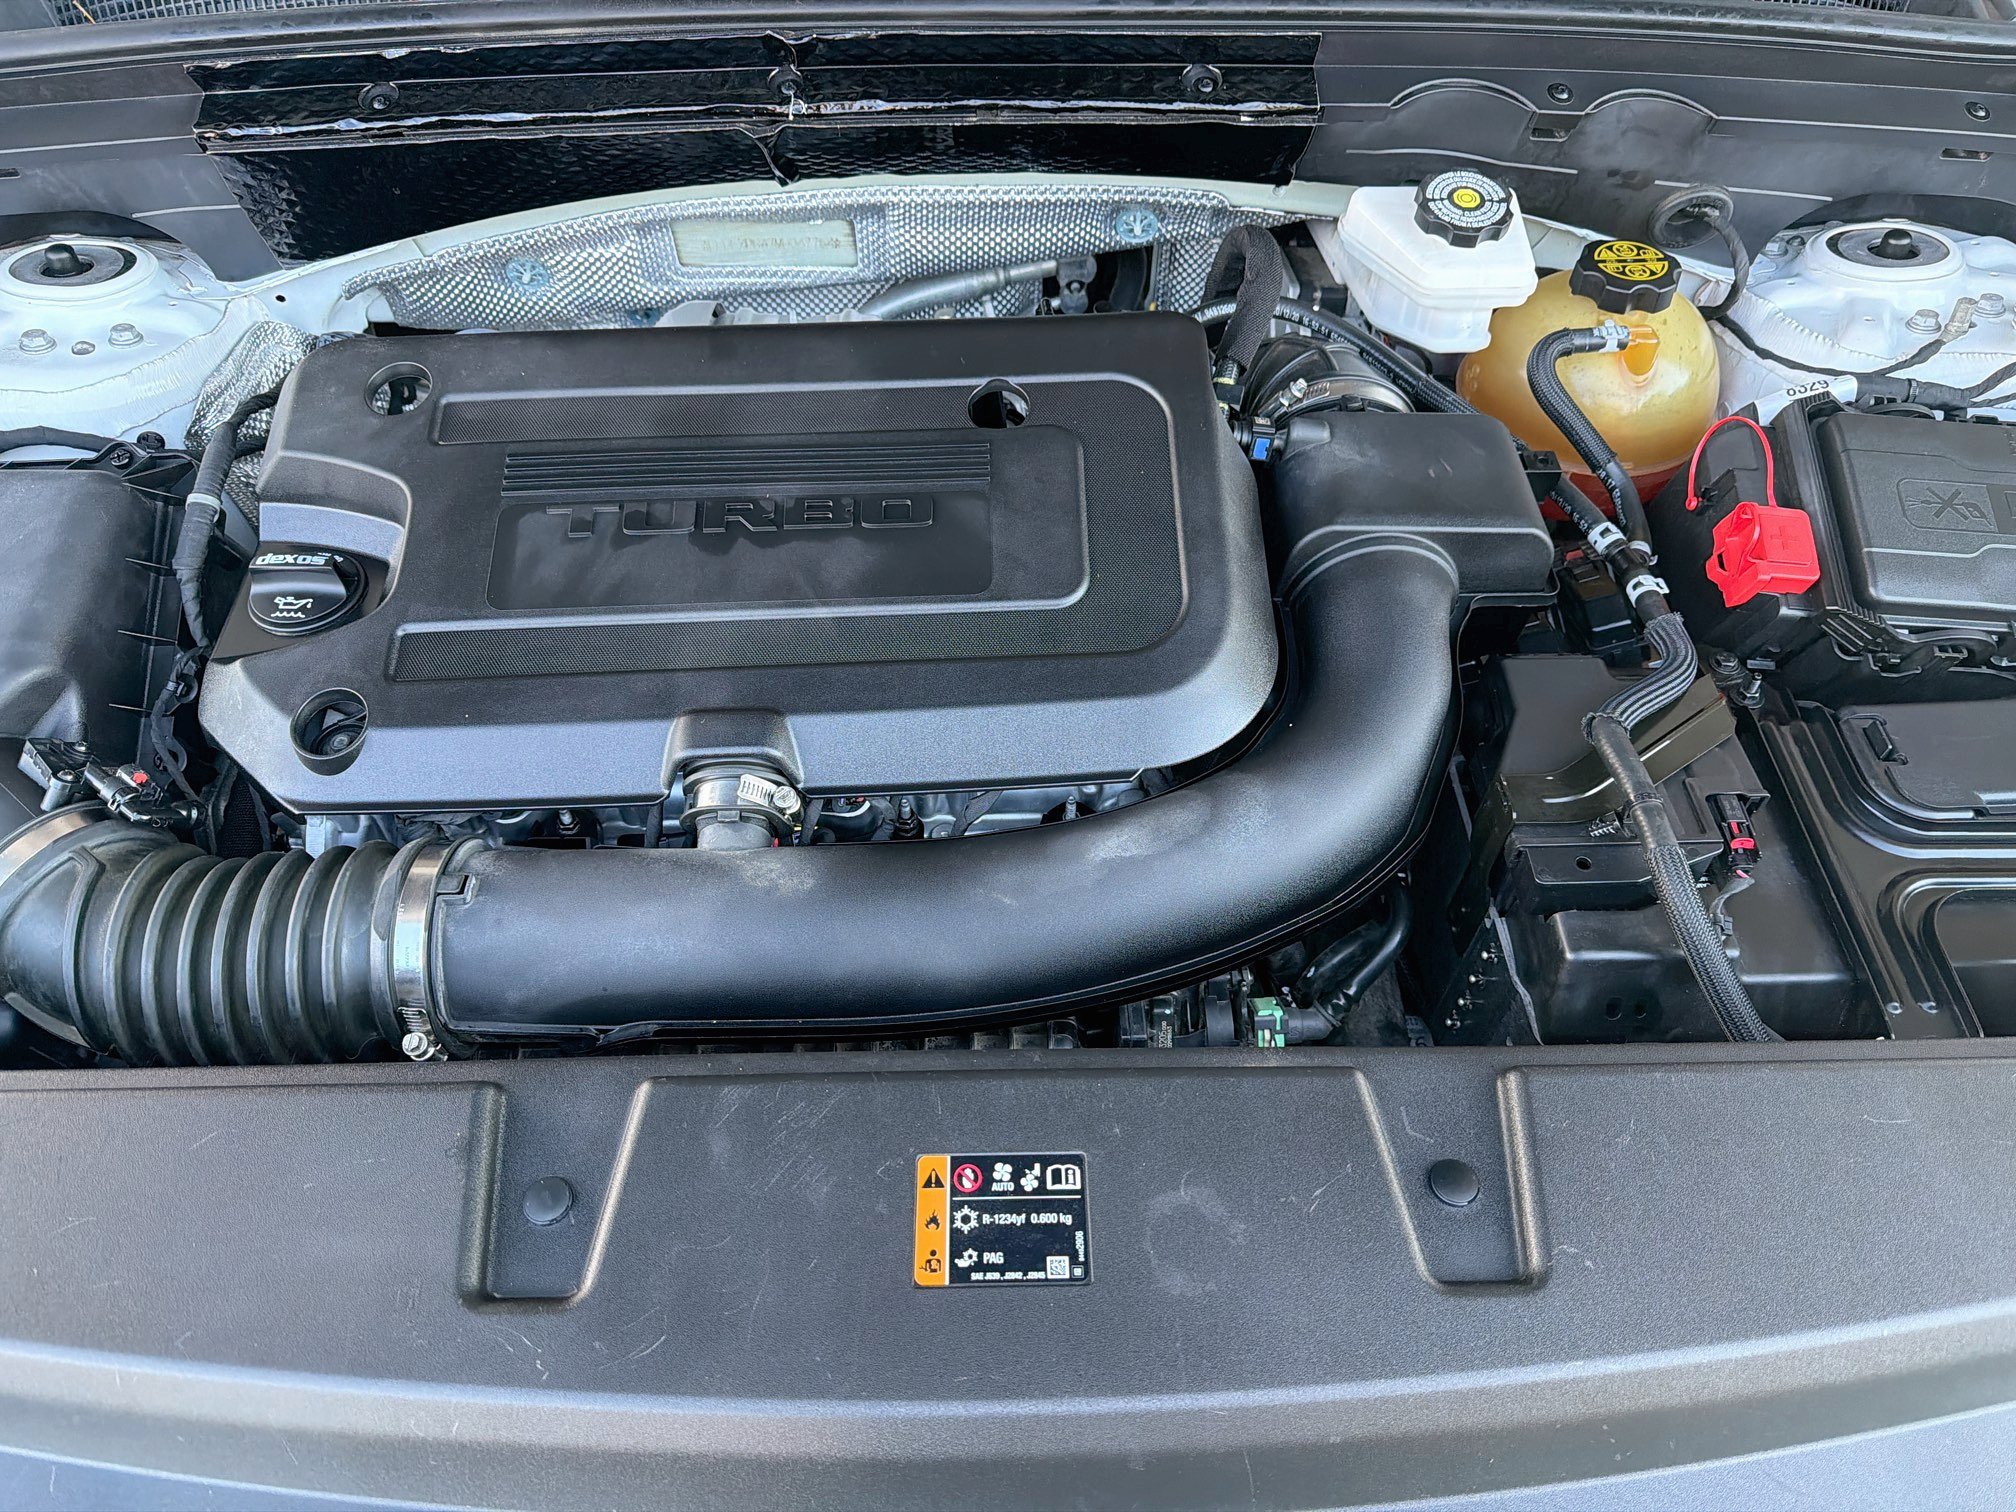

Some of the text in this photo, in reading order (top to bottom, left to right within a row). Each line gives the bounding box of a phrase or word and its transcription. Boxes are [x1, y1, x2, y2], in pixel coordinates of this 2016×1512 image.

[546, 494, 934, 538] TURBO
[255, 552, 329, 566] dexos
[991, 1182, 1014, 1191] AUTO
[982, 1213, 1073, 1227] R-1234yf 0.600 kg
[983, 1252, 1004, 1264] PAG
